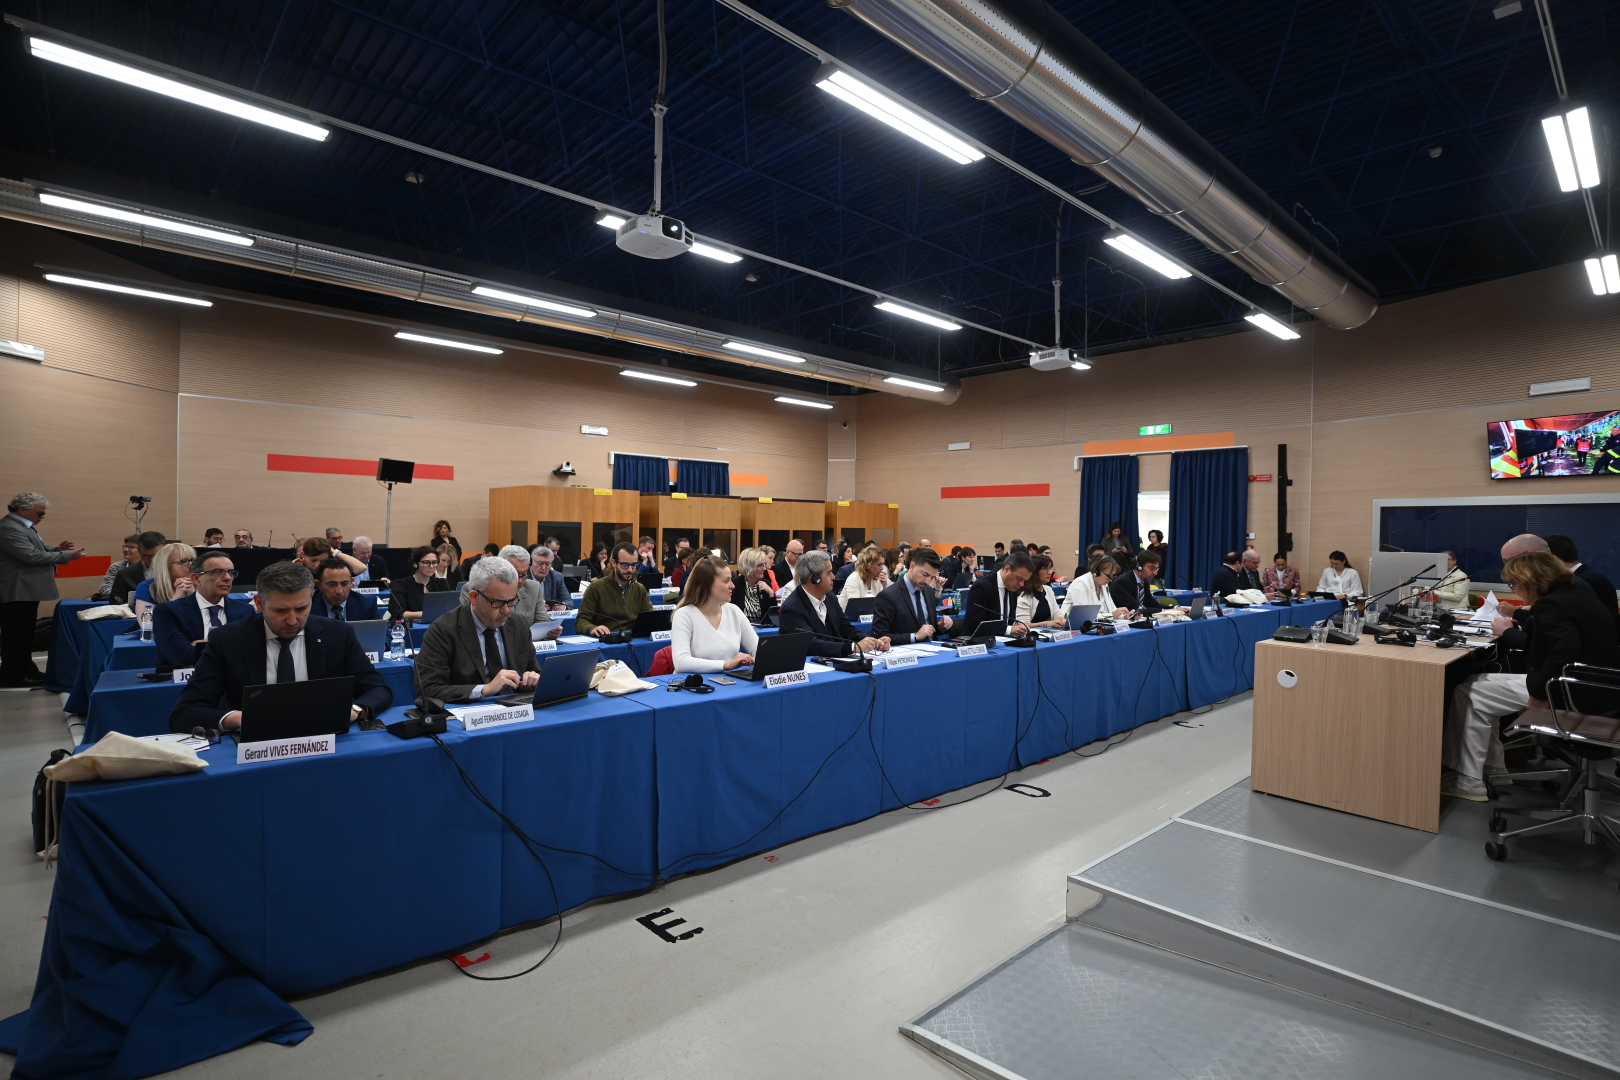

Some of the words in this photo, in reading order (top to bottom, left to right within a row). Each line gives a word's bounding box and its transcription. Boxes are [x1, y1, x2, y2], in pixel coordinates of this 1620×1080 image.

[655, 632, 671, 640] Carlos
[769, 675, 787, 686] Elodie
[787, 672, 806, 682] NUNES
[484, 711, 507, 724] FERNÁNDEZ
[508, 712, 513, 720] DE
[514, 709, 530, 719] LOSADA
[244, 746, 268, 760] Gerard
[269, 744, 289, 757] VIVES
[290, 740, 329, 755] FERNÁNDEZ
[635, 907, 705, 944] E
